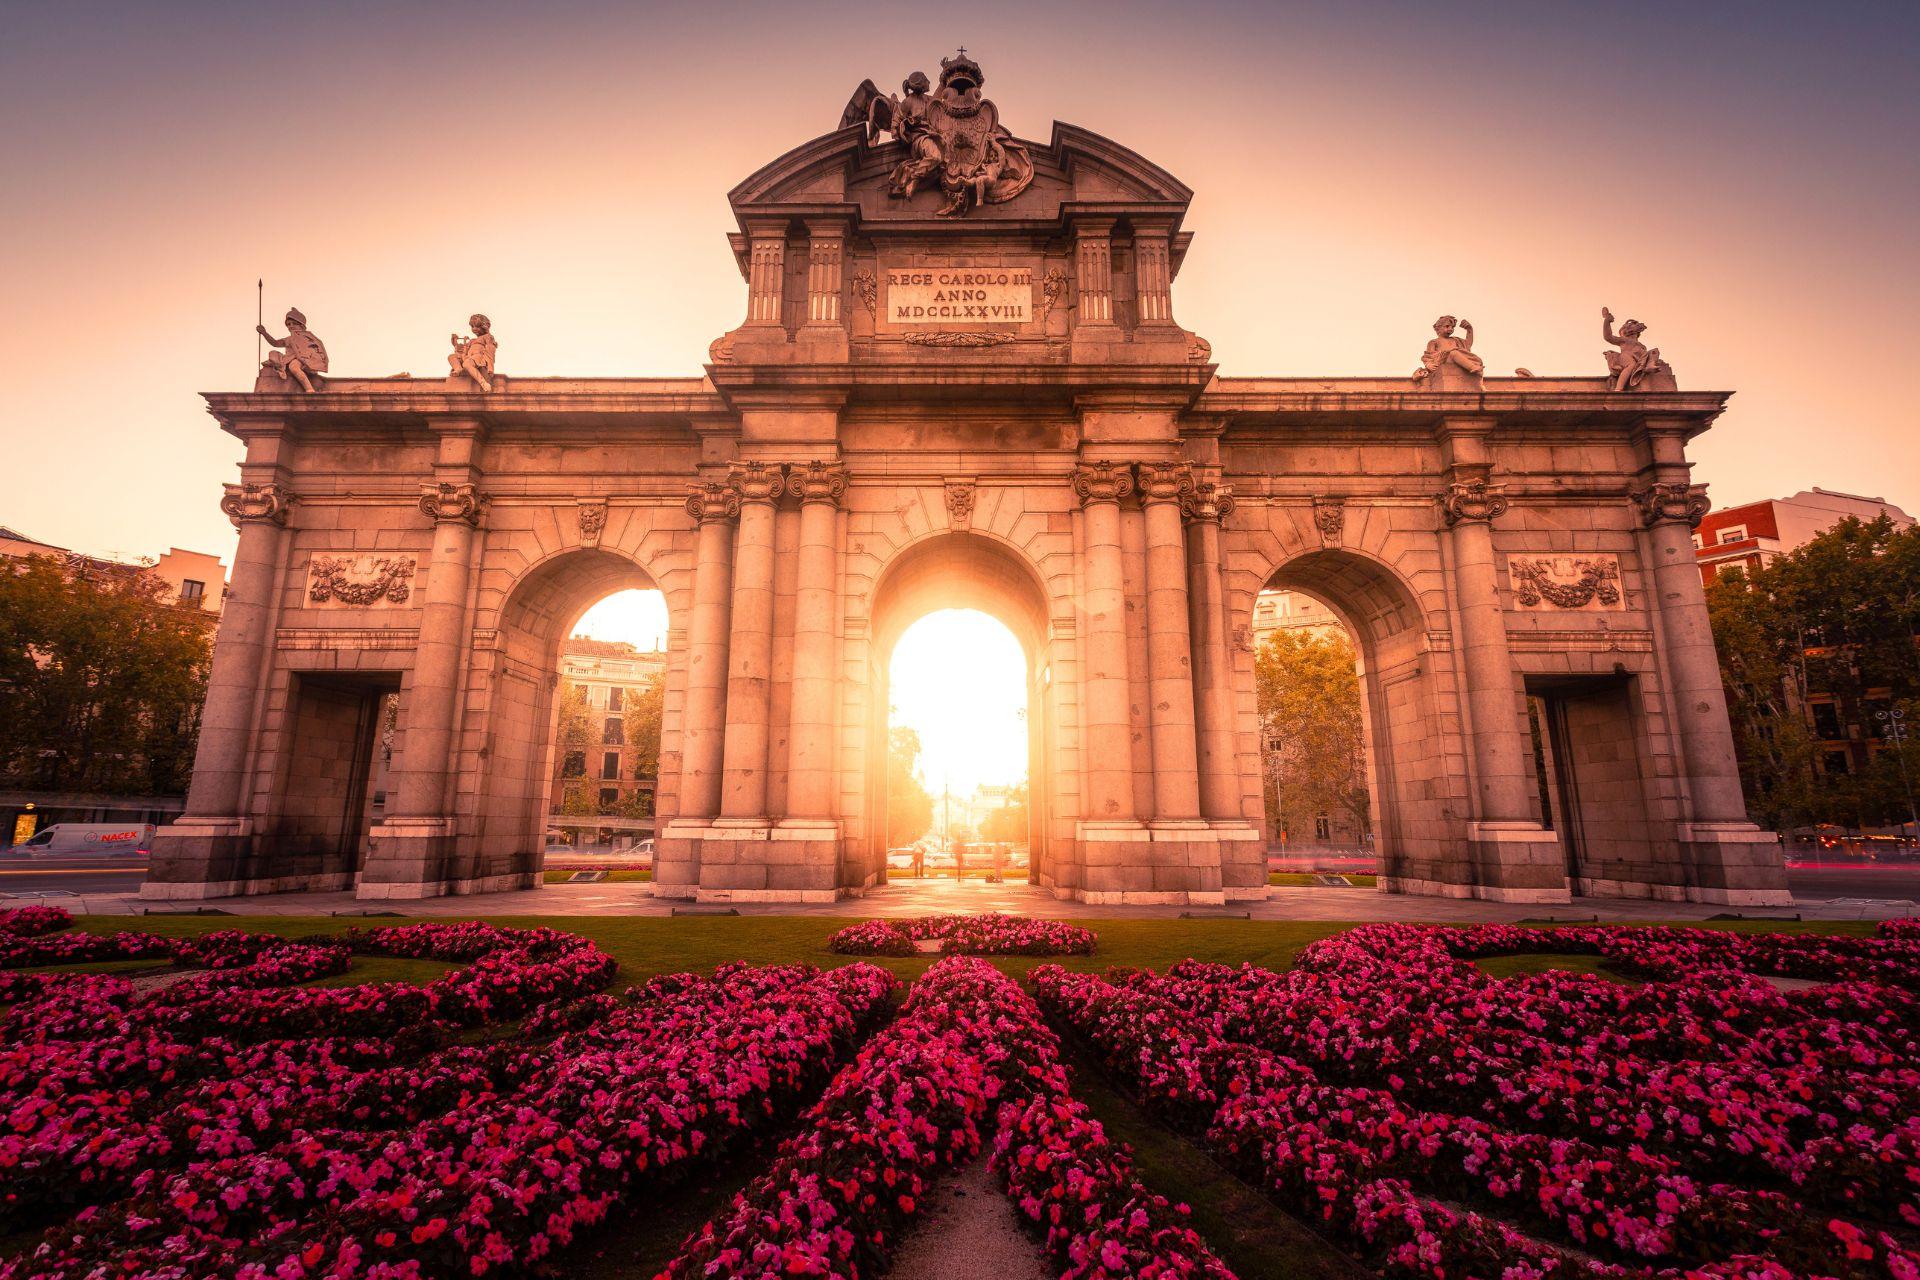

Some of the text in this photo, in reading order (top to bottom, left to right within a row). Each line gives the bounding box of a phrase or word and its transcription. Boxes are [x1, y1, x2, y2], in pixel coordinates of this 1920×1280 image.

[888, 274, 1032, 286] REGE CAROLO III
[934, 290, 987, 301] ANNO
[897, 306, 1023, 318] MDCCLXXVIII
[101, 831, 138, 842] NACEX
